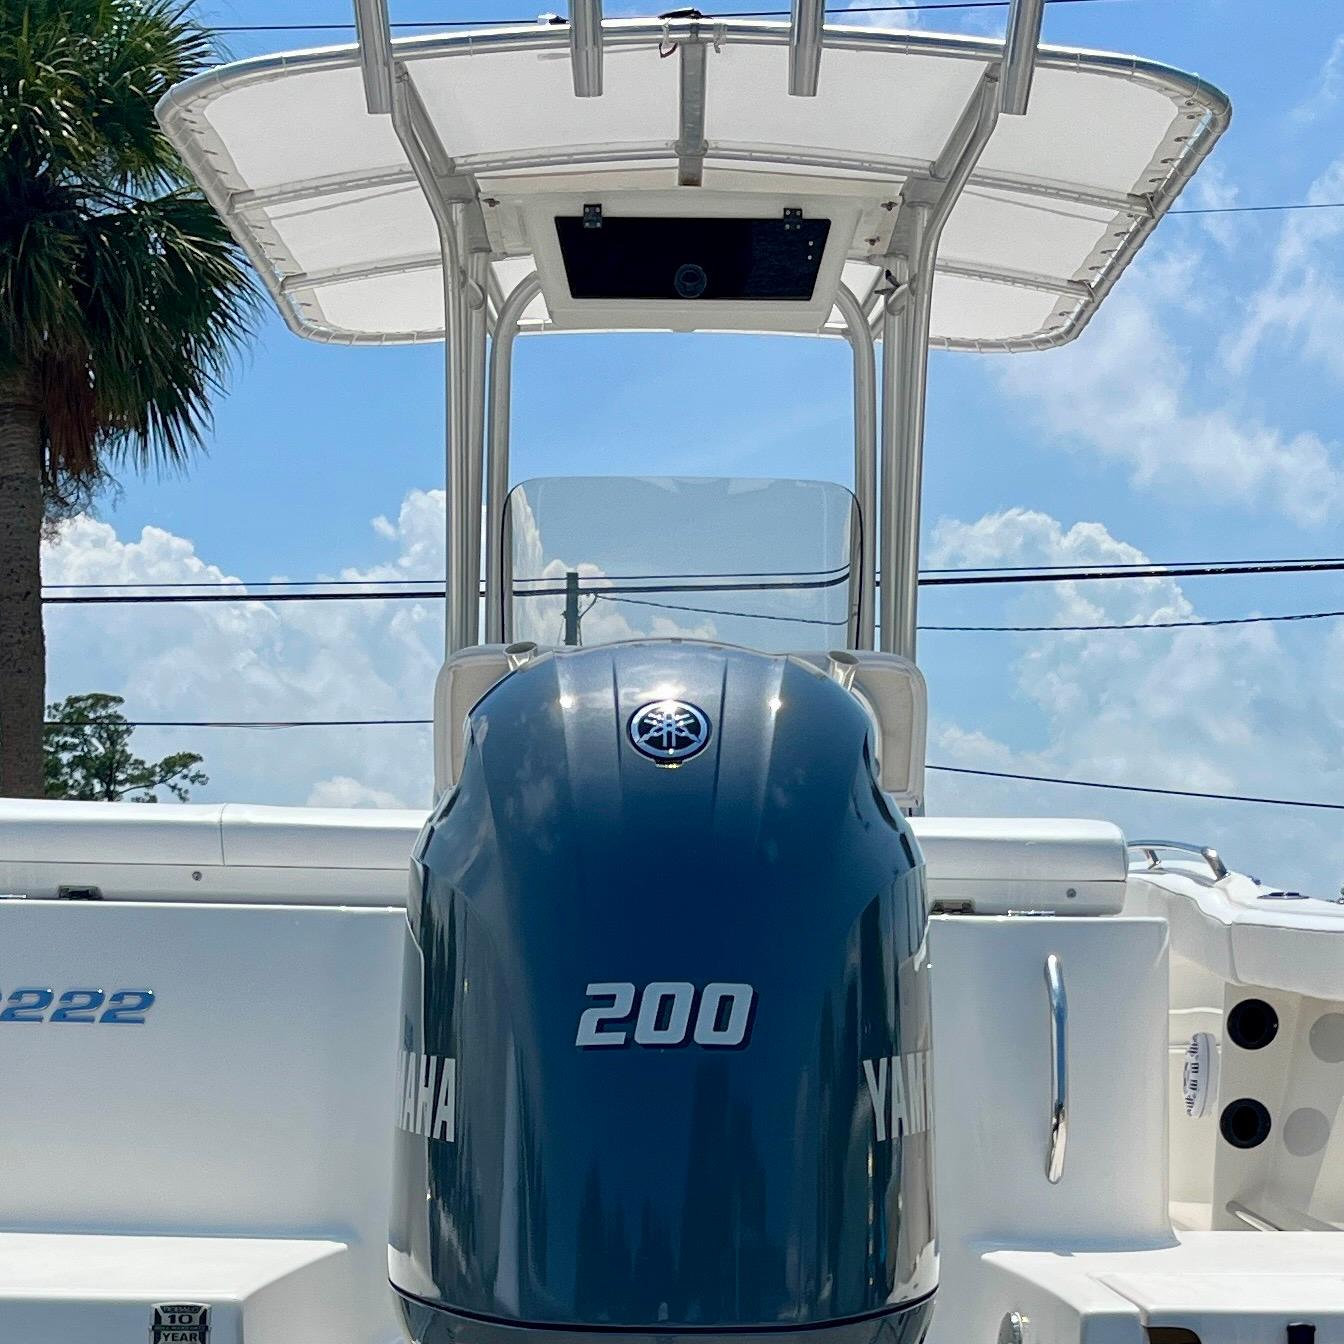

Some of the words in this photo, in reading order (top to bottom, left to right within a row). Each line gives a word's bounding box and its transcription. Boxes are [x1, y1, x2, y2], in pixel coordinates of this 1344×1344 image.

[575, 981, 756, 1048] 200
[167, 1314, 193, 1325] 10
[162, 1332, 199, 1342] YEAR
